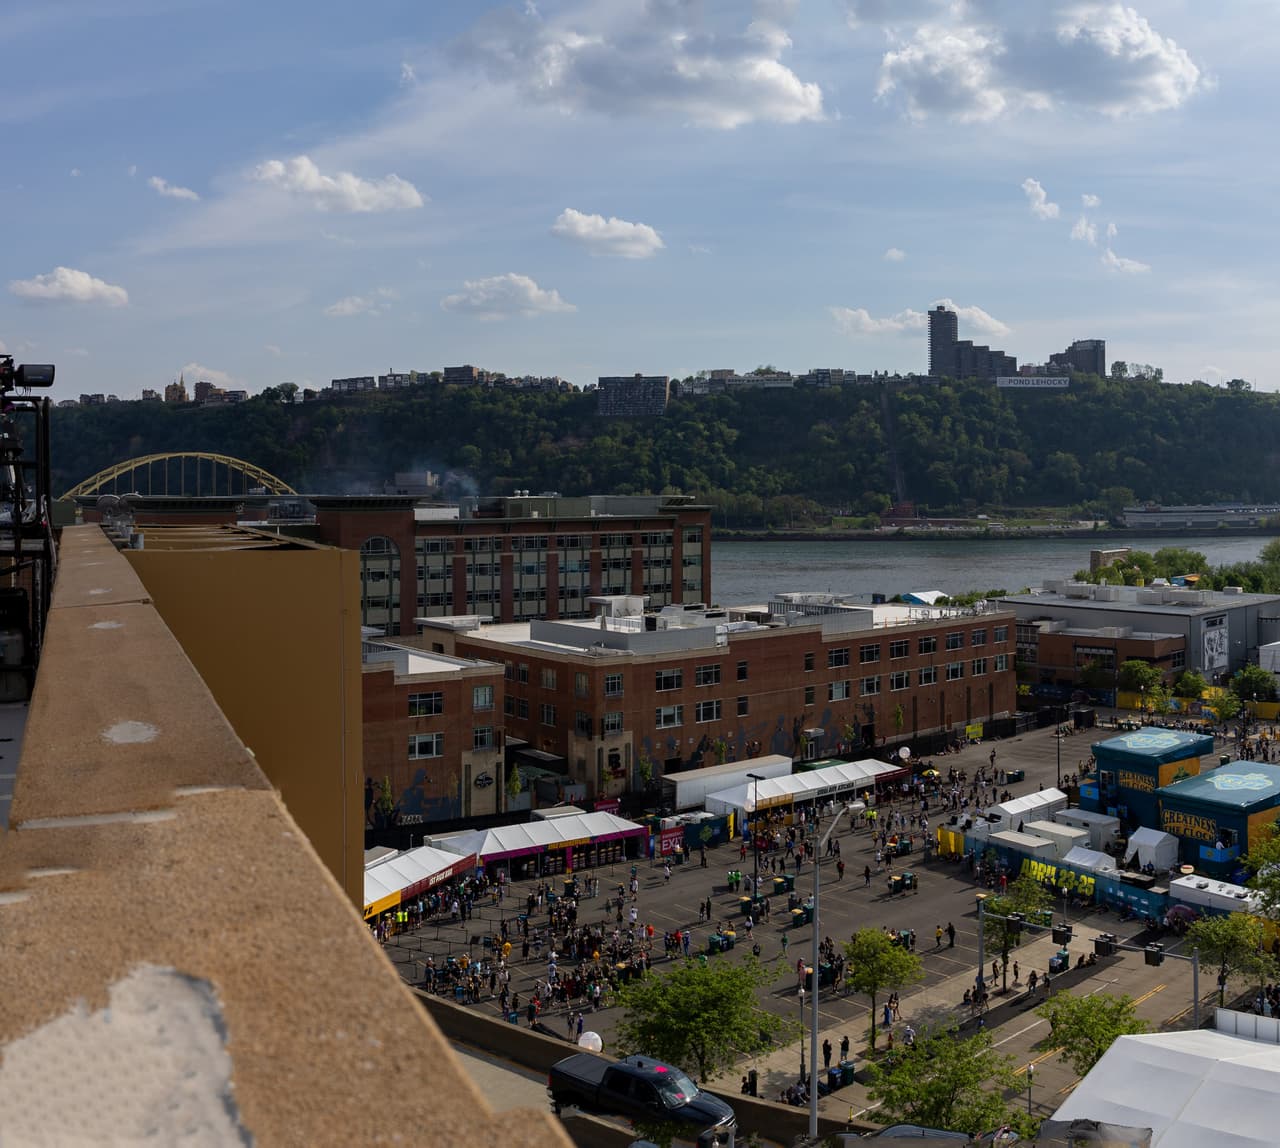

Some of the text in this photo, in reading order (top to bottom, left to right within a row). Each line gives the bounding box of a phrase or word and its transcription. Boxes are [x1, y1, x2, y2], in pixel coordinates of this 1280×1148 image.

[1119, 768, 1156, 787] GREATNESS
[1162, 809, 1217, 834] GREATNESS
[662, 837, 684, 851] EXIT
[1183, 828, 1216, 842] CLOCK
[1020, 858, 1096, 896] APRIL 23-25
